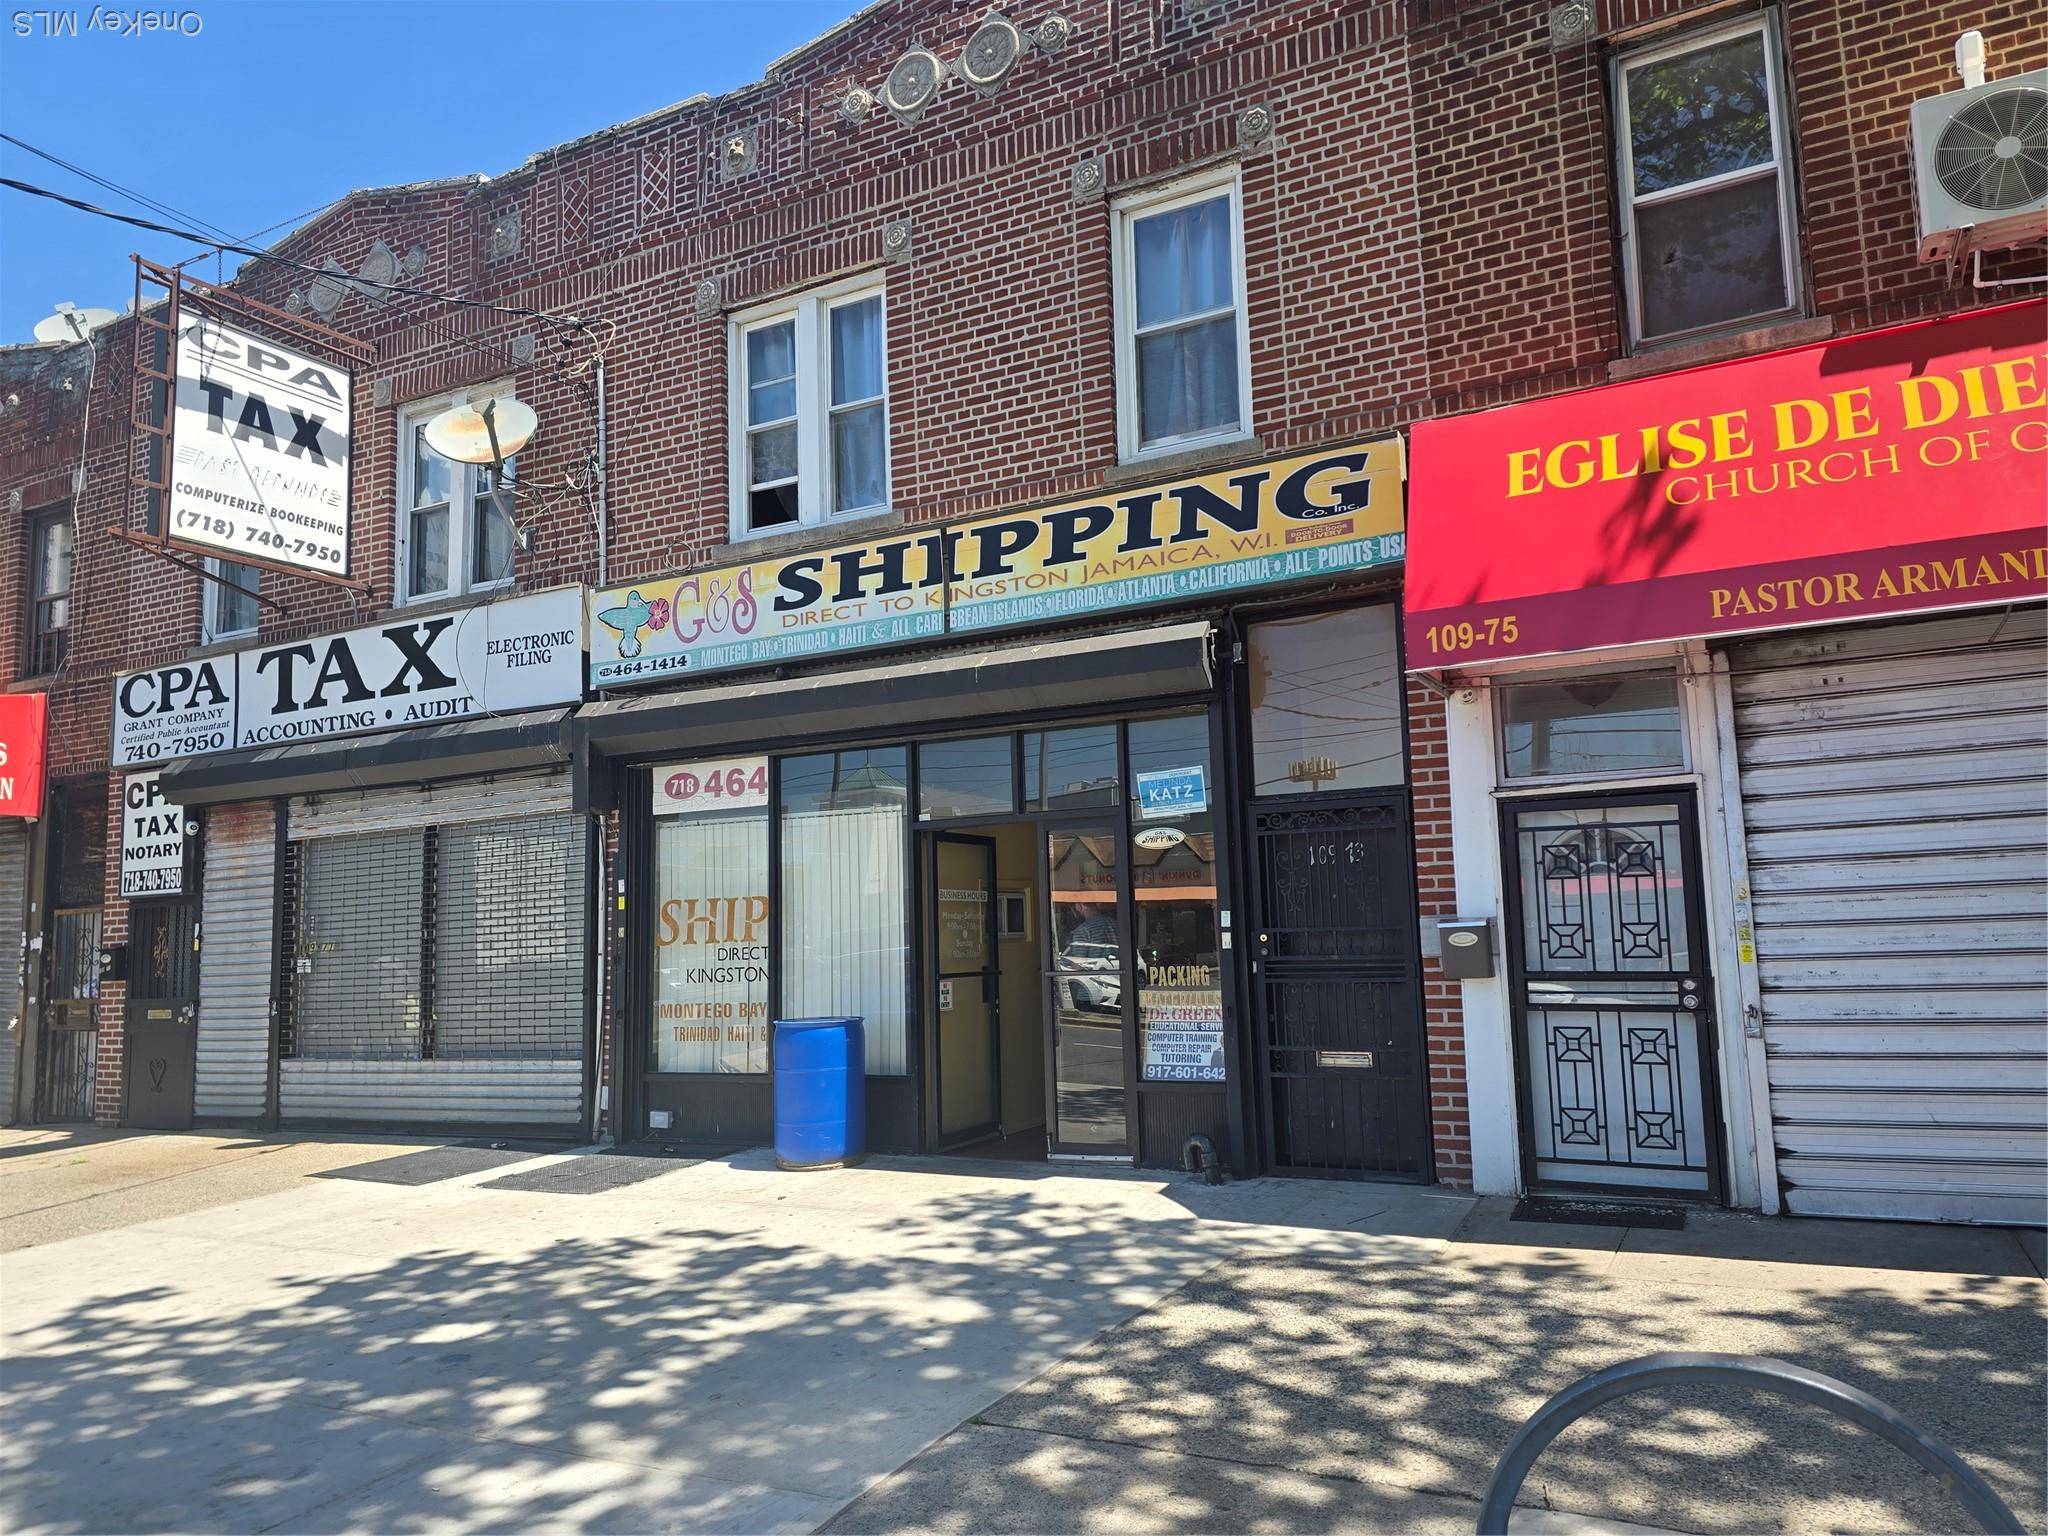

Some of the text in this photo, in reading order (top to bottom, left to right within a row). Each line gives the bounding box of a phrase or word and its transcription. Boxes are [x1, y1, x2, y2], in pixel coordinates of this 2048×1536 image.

[186, 324, 343, 401] CPA
[200, 379, 329, 469] TAX
[1505, 353, 2048, 498] EGLISE DE DIE
[1665, 443, 1902, 506] CHURCH
[1919, 429, 1990, 467] OF
[175, 481, 344, 537] COMPUTERIZE BOOKEEPING
[1302, 503, 1360, 518] Co. Inc.
[176, 508, 341, 564] (718) 740-7950
[773, 452, 1372, 612] SHIPPING
[1295, 529, 1343, 542] DELIVERY
[782, 532, 1278, 628] DIRECT TO KINGSTON JAMAICA, W.I.
[672, 566, 758, 644] G&S
[701, 644, 748, 667] MONTEGO
[752, 640, 772, 658] BAY
[782, 632, 828, 655] TRINIDAD
[838, 625, 867, 646] HAITI
[872, 622, 885, 639] &
[891, 619, 910, 636] ALL
[916, 607, 988, 633] CARIBBEAN
[993, 596, 1043, 622] ISLANDS
[1055, 587, 1104, 611] FLORIDA
[1117, 574, 1175, 600] ATLANTA
[1189, 560, 1271, 590] CALIFORNIA
[1285, 551, 1311, 574] ALL
[1318, 541, 1373, 569] POINTS
[1709, 572, 1865, 618] PASTOR
[486, 630, 575, 656] ELECTRONIC
[1426, 615, 1519, 653] 109-75
[256, 616, 457, 716] TAX
[506, 650, 552, 669] FILING
[612, 655, 688, 677] 464-1414
[119, 662, 230, 718] CPA
[121, 720, 230, 745] Certified Public Accountant
[123, 708, 225, 733] GRANT COMPANY
[242, 695, 474, 745] ACCOUNTING AUDIT
[125, 732, 225, 762] 740-7950
[127, 779, 172, 809] CP
[671, 766, 768, 798] 718 464
[1149, 784, 1194, 802] KATZ
[134, 813, 179, 838] TAX
[125, 842, 182, 861] NOTARY
[1141, 834, 1179, 844] SHIPPING
[125, 868, 182, 892] 718-740-7950
[656, 895, 768, 946] SHIP
[718, 946, 768, 962] DIRECT
[686, 966, 769, 983] KINGSTON
[1149, 965, 1210, 987] PACKING
[660, 1002, 767, 1019] MONTEGO BAY
[1150, 1008, 1169, 1020] Dr.
[673, 1026, 720, 1042] TRINIDAD
[728, 1025, 755, 1042] HAITI
[1147, 1033, 1217, 1043] COMPUTER TRAINING
[1150, 1022, 1199, 1031] EDUCATIONAL
[1152, 1043, 1212, 1053] COMPUTER REPAIR
[1161, 1053, 1202, 1064] TUTORING
